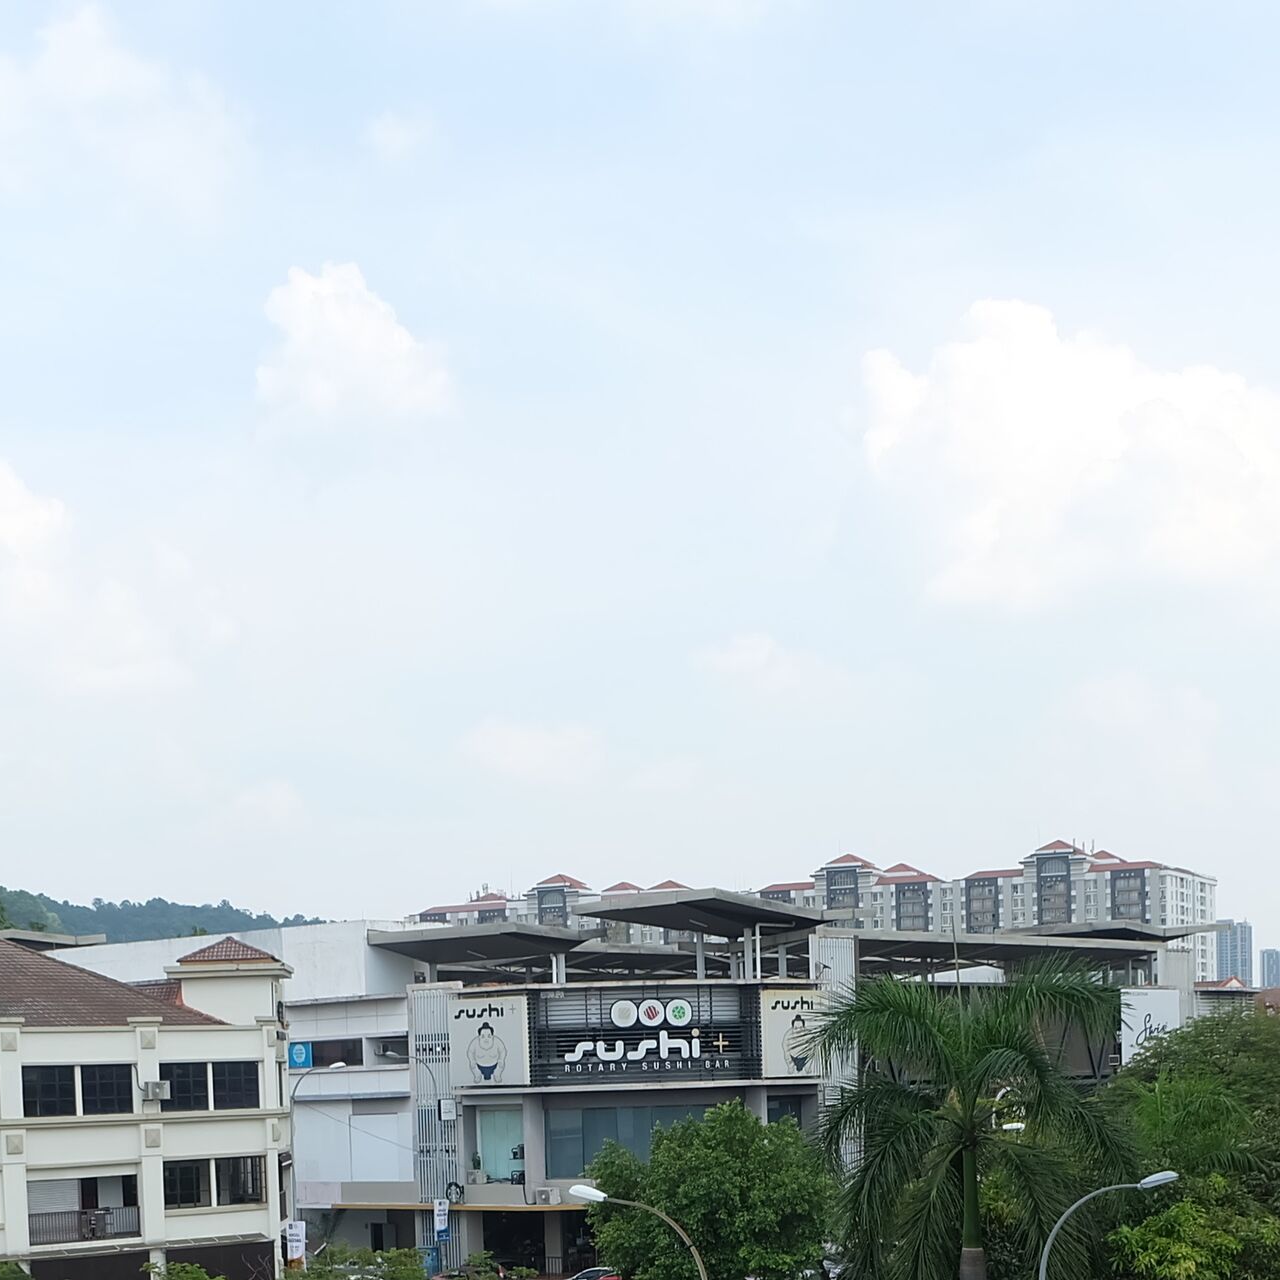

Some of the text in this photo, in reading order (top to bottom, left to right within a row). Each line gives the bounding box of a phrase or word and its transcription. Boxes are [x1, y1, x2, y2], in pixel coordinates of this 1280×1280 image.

[454, 1002, 504, 1019] sushi
[771, 996, 814, 1010] sushi
[564, 1028, 700, 1062] sushi
[564, 1059, 730, 1073] ROTARY SUSHI BAR
